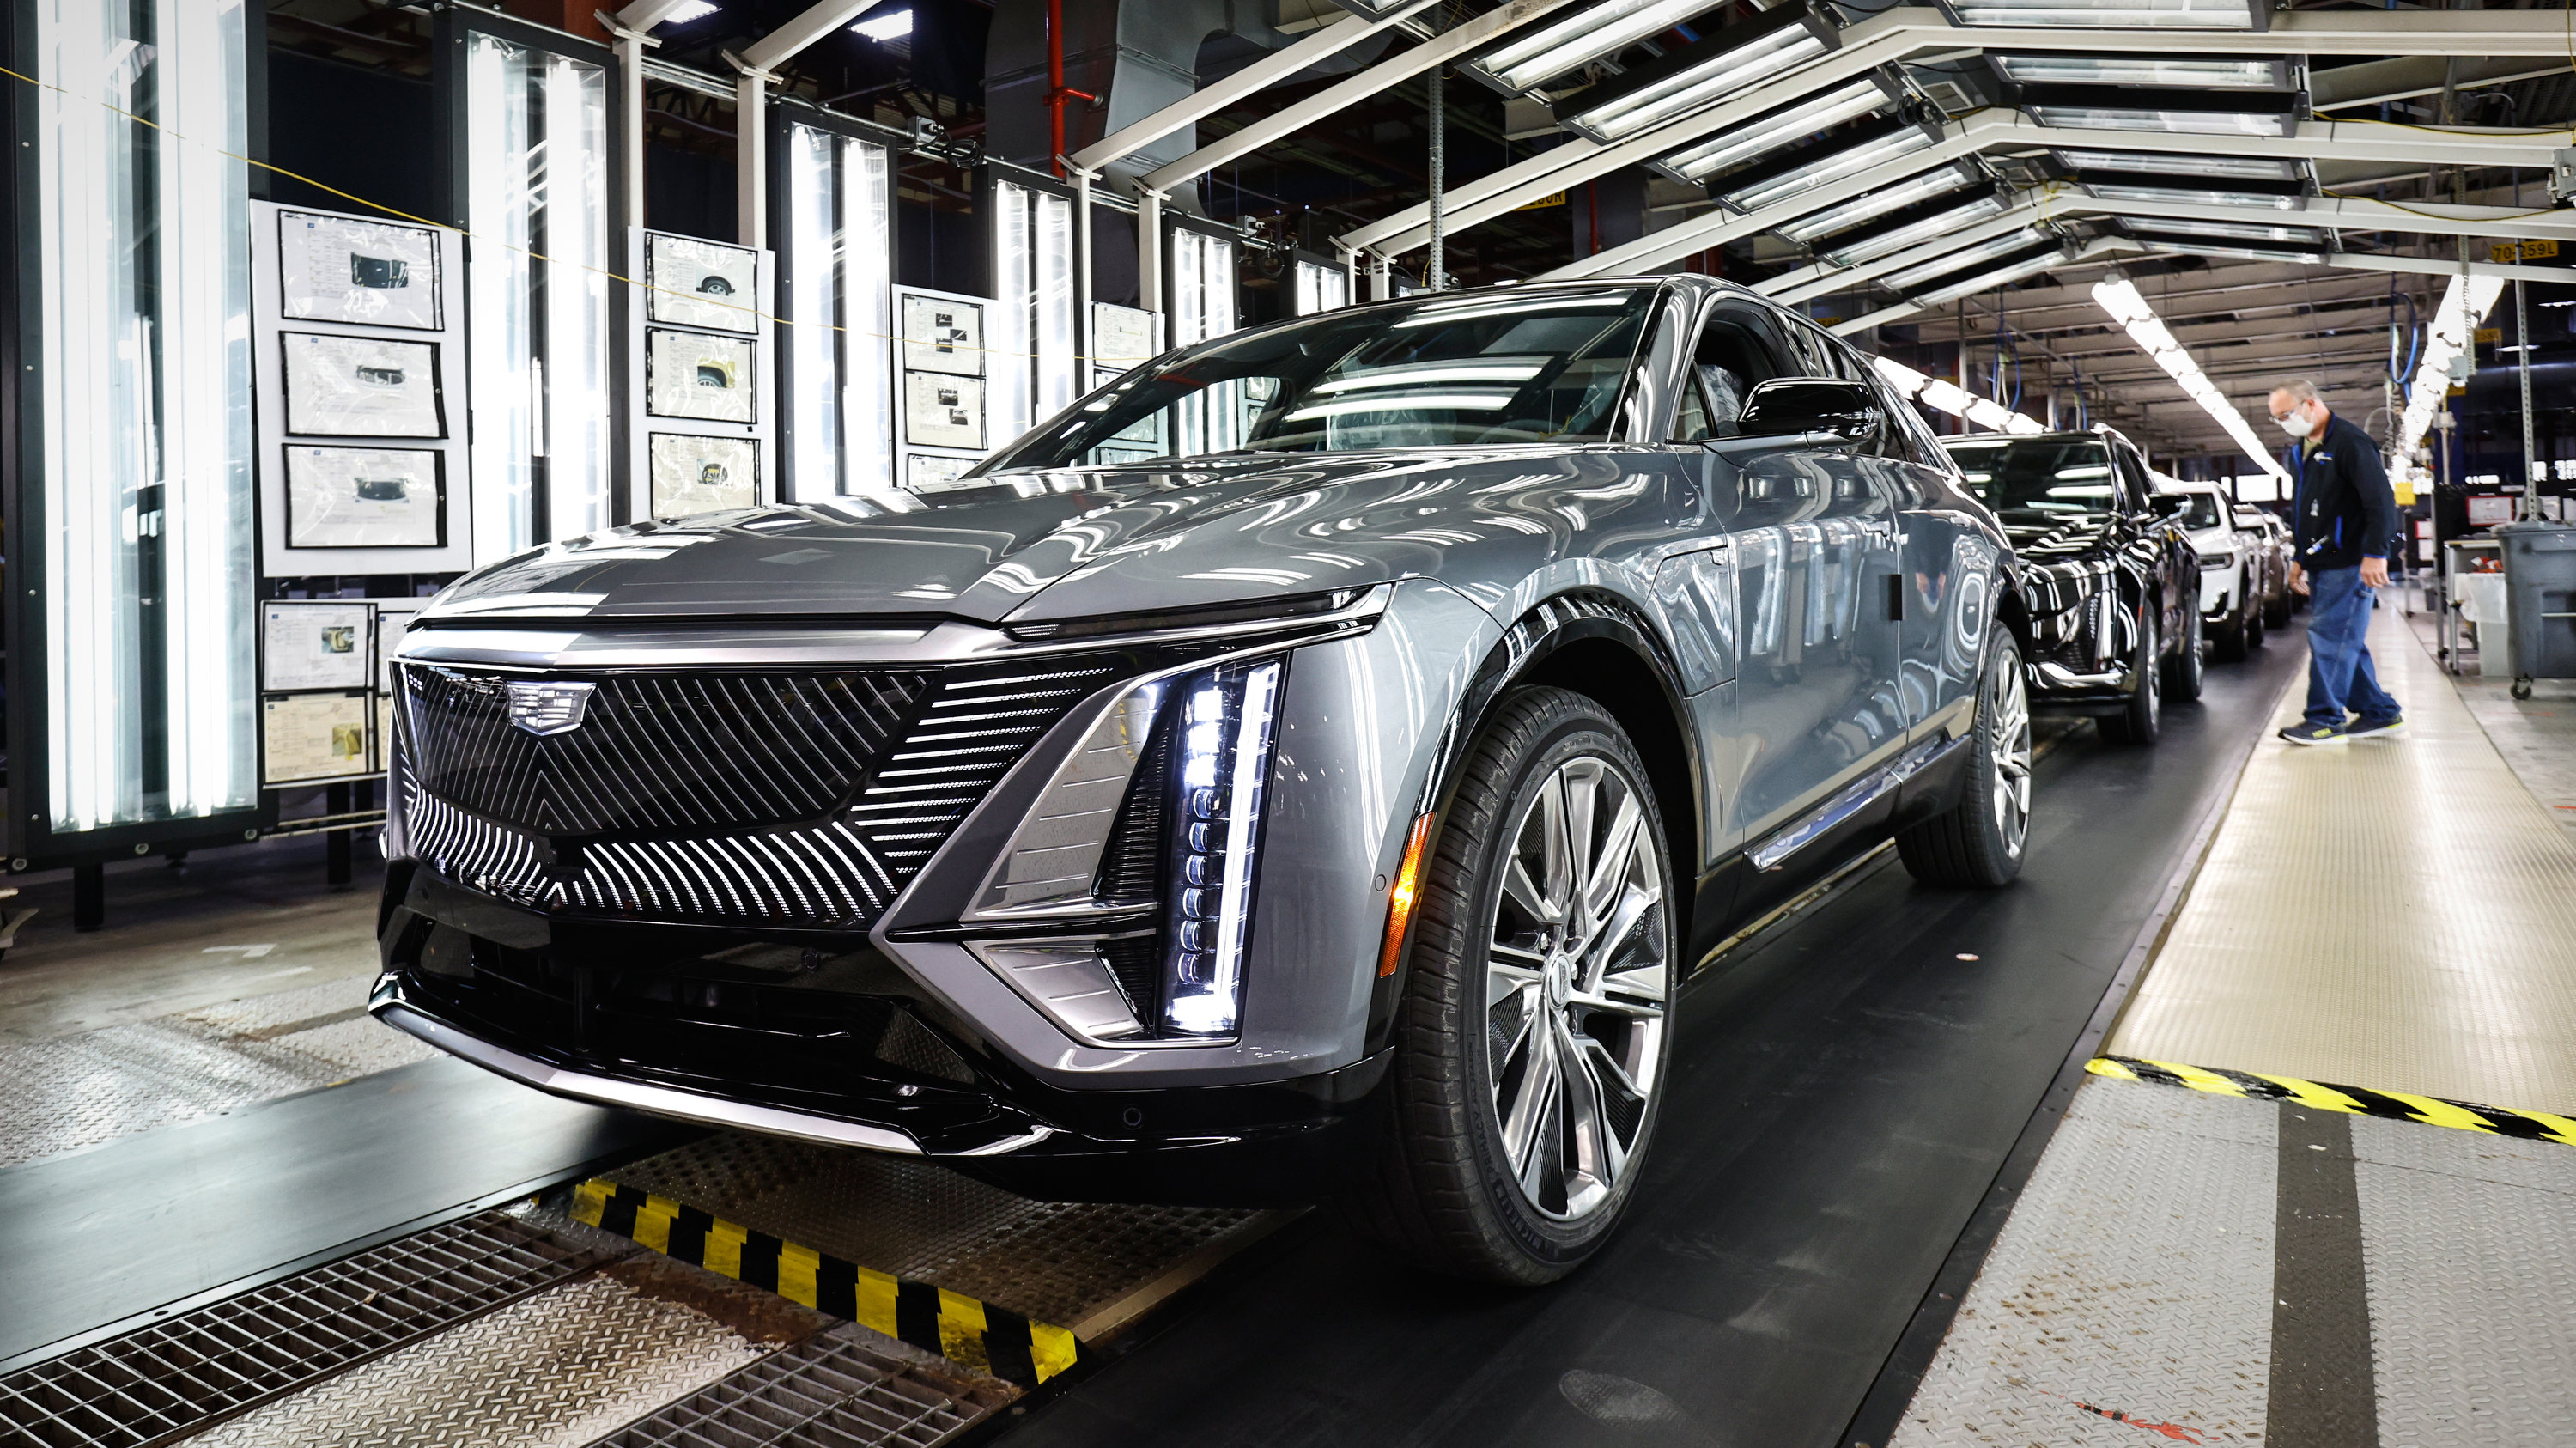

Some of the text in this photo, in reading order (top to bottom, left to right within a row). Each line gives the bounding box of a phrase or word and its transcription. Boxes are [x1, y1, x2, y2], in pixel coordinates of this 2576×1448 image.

[2494, 243, 2555, 259] 70-259L
[1473, 1110, 1495, 1174] PRIMACY
[1493, 1185, 1543, 1249] MICHELIN
